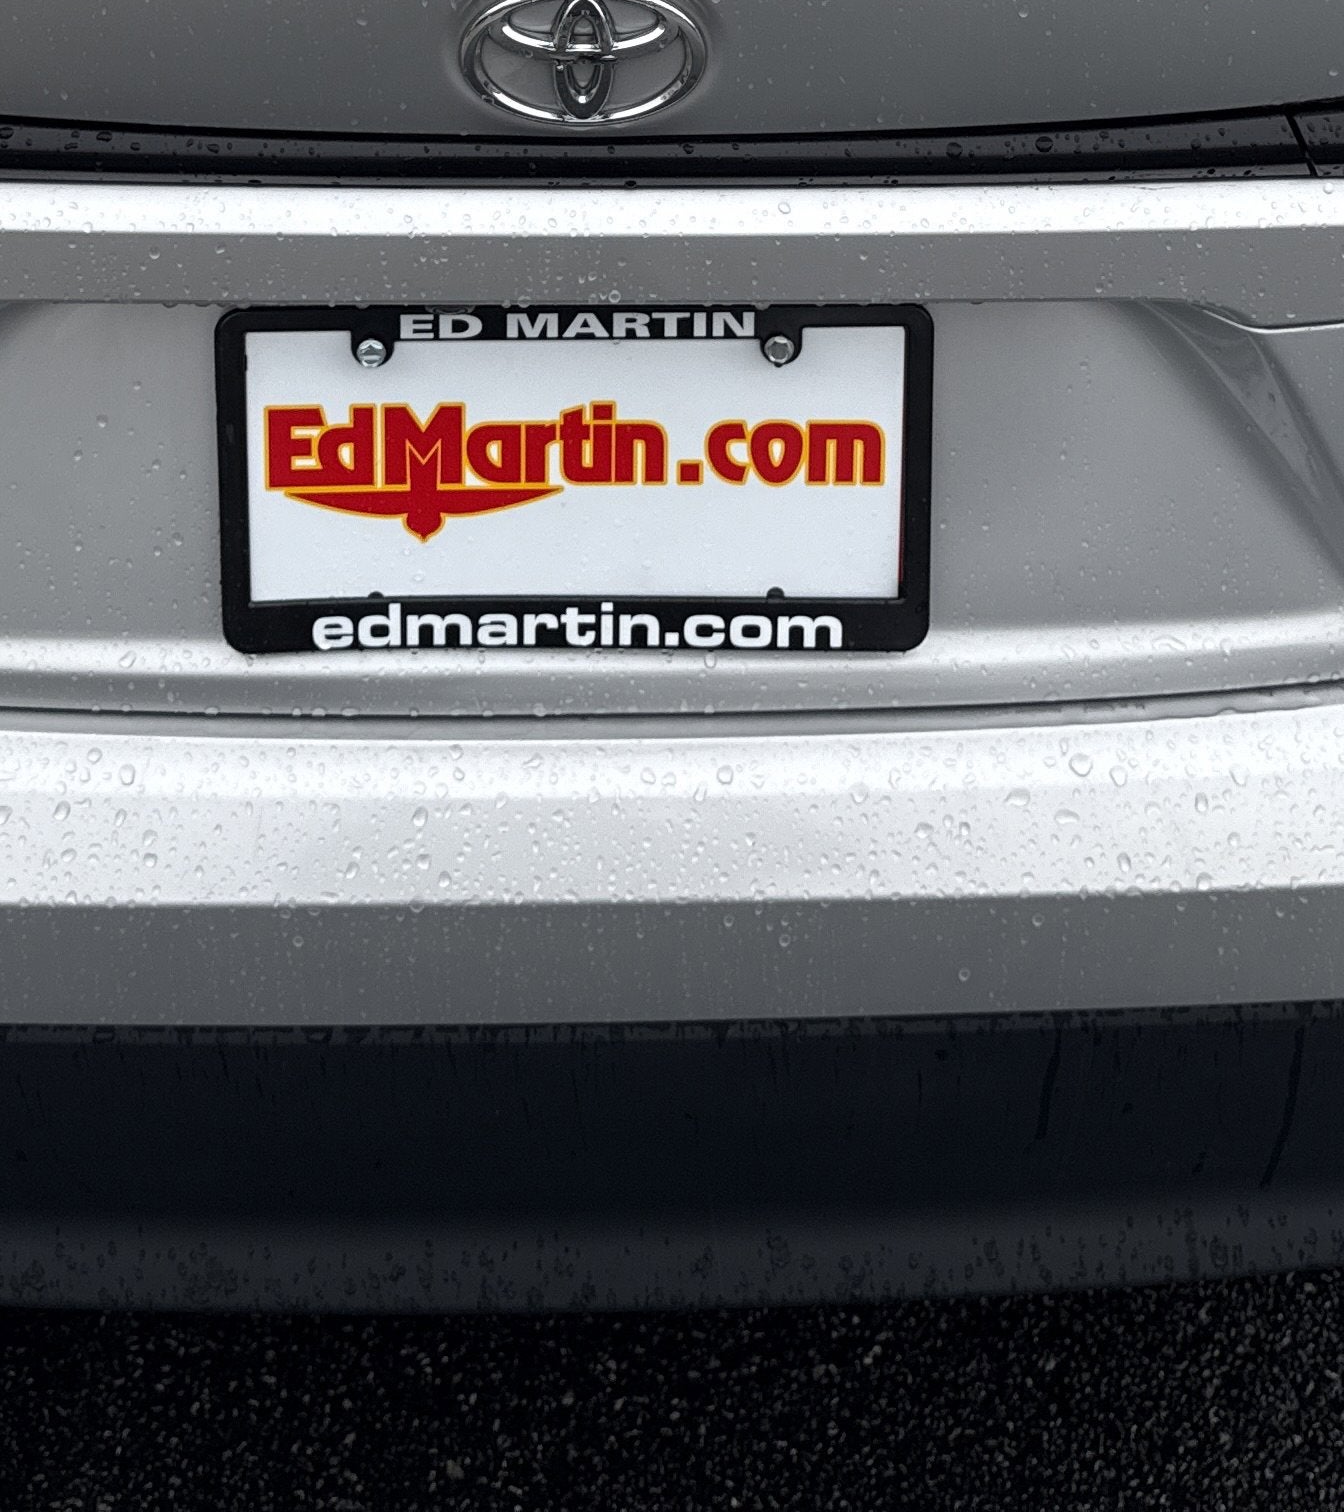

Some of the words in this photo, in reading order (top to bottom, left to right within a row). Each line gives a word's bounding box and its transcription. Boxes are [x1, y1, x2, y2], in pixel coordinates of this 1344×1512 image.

[399, 312, 484, 340] ED
[505, 311, 757, 339] MARTIN
[263, 399, 887, 494] EdMartin.com
[311, 601, 845, 651] edmartin.com
